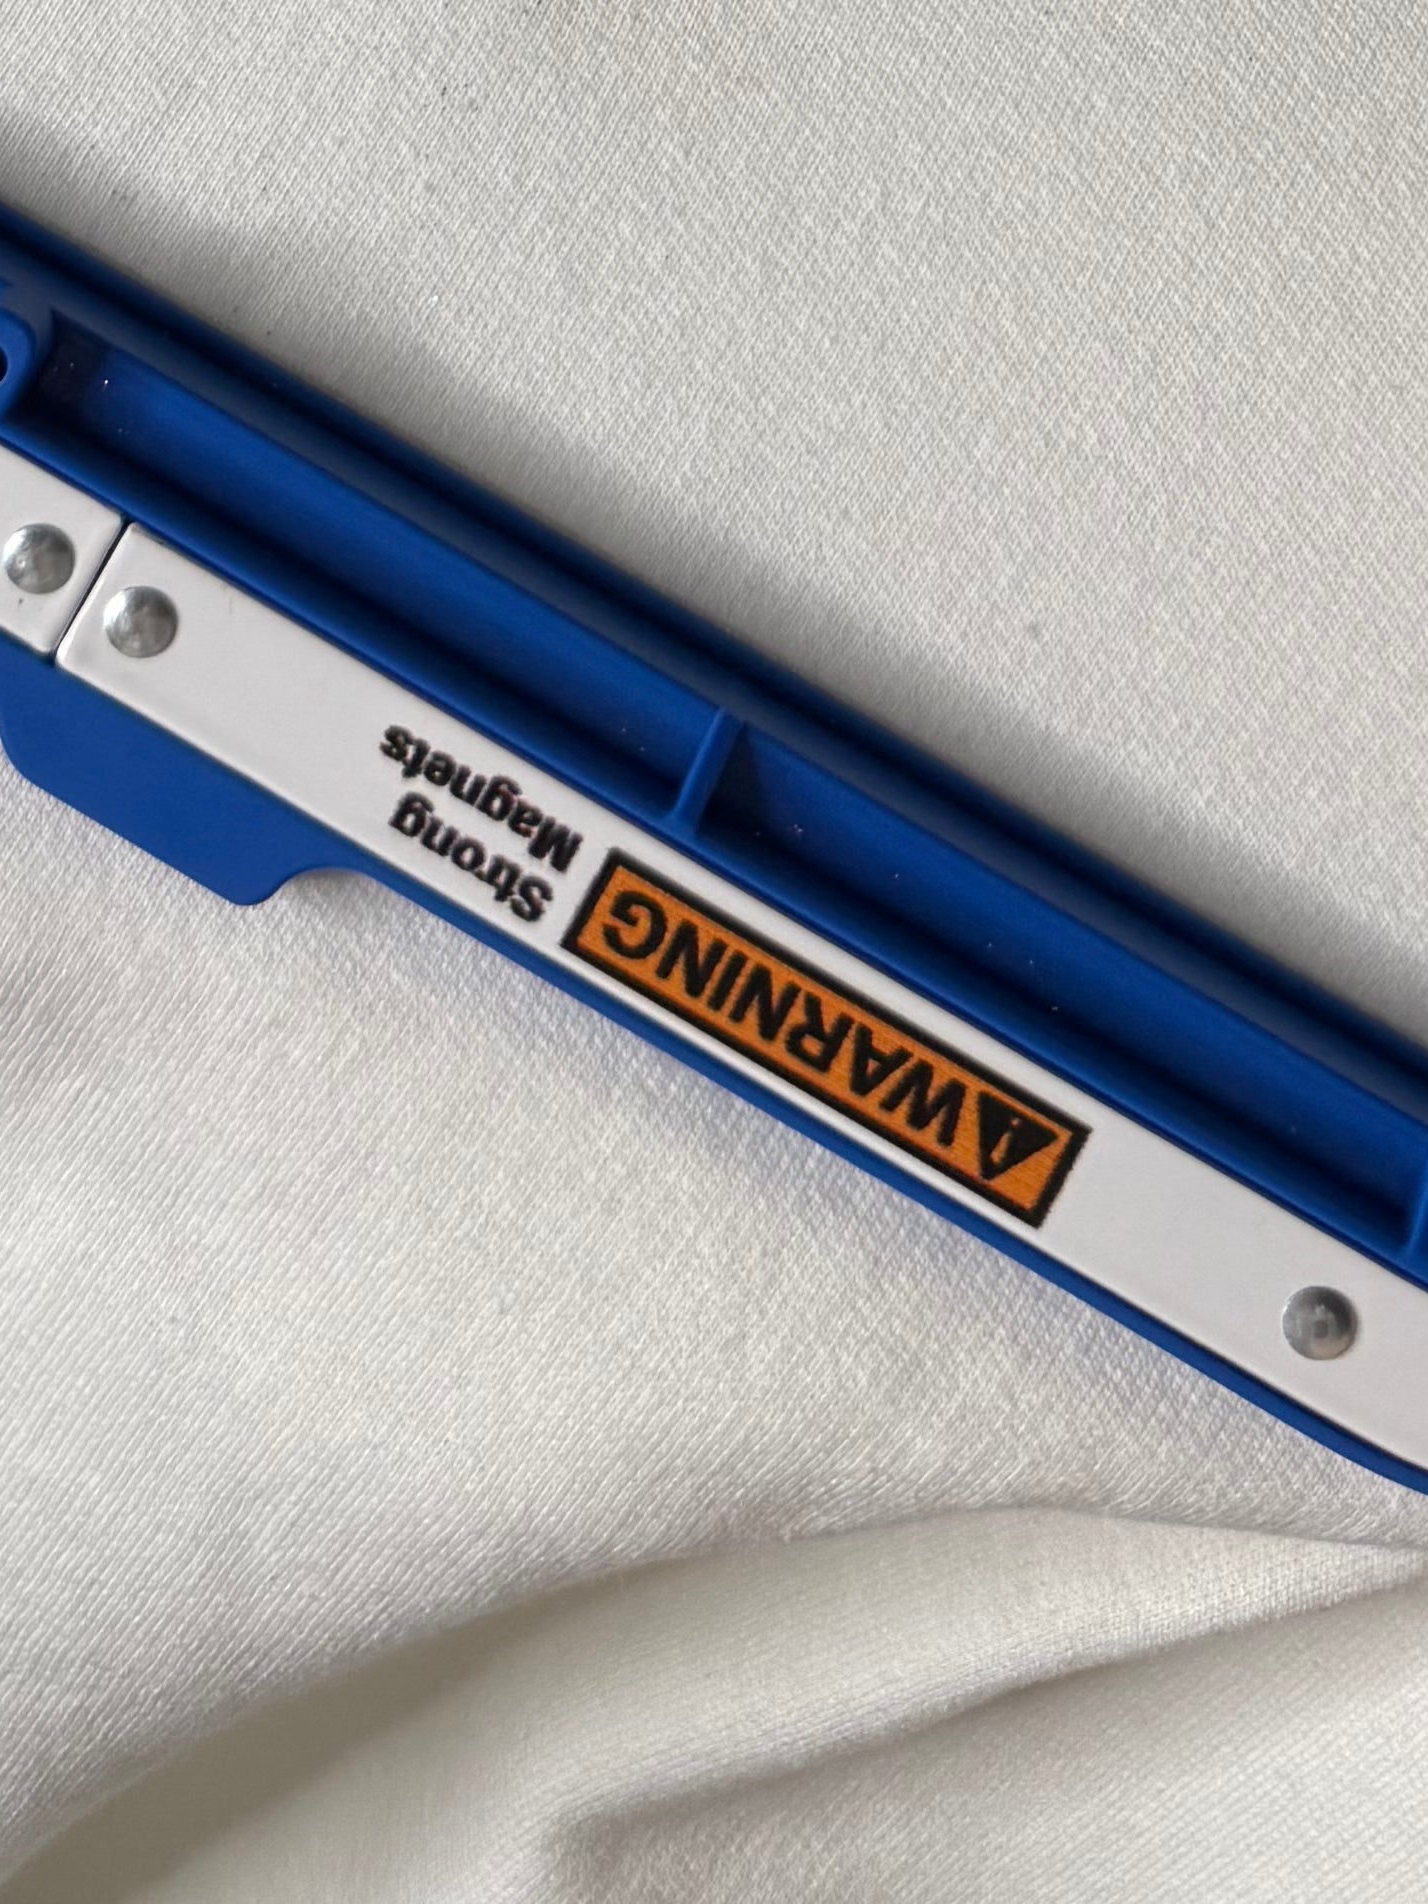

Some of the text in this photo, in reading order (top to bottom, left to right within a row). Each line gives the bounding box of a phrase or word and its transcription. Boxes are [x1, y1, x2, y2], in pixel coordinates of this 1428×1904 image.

[379, 724, 584, 874] Magnets
[387, 790, 554, 923] Strong
[600, 888, 971, 1151] WARNING
